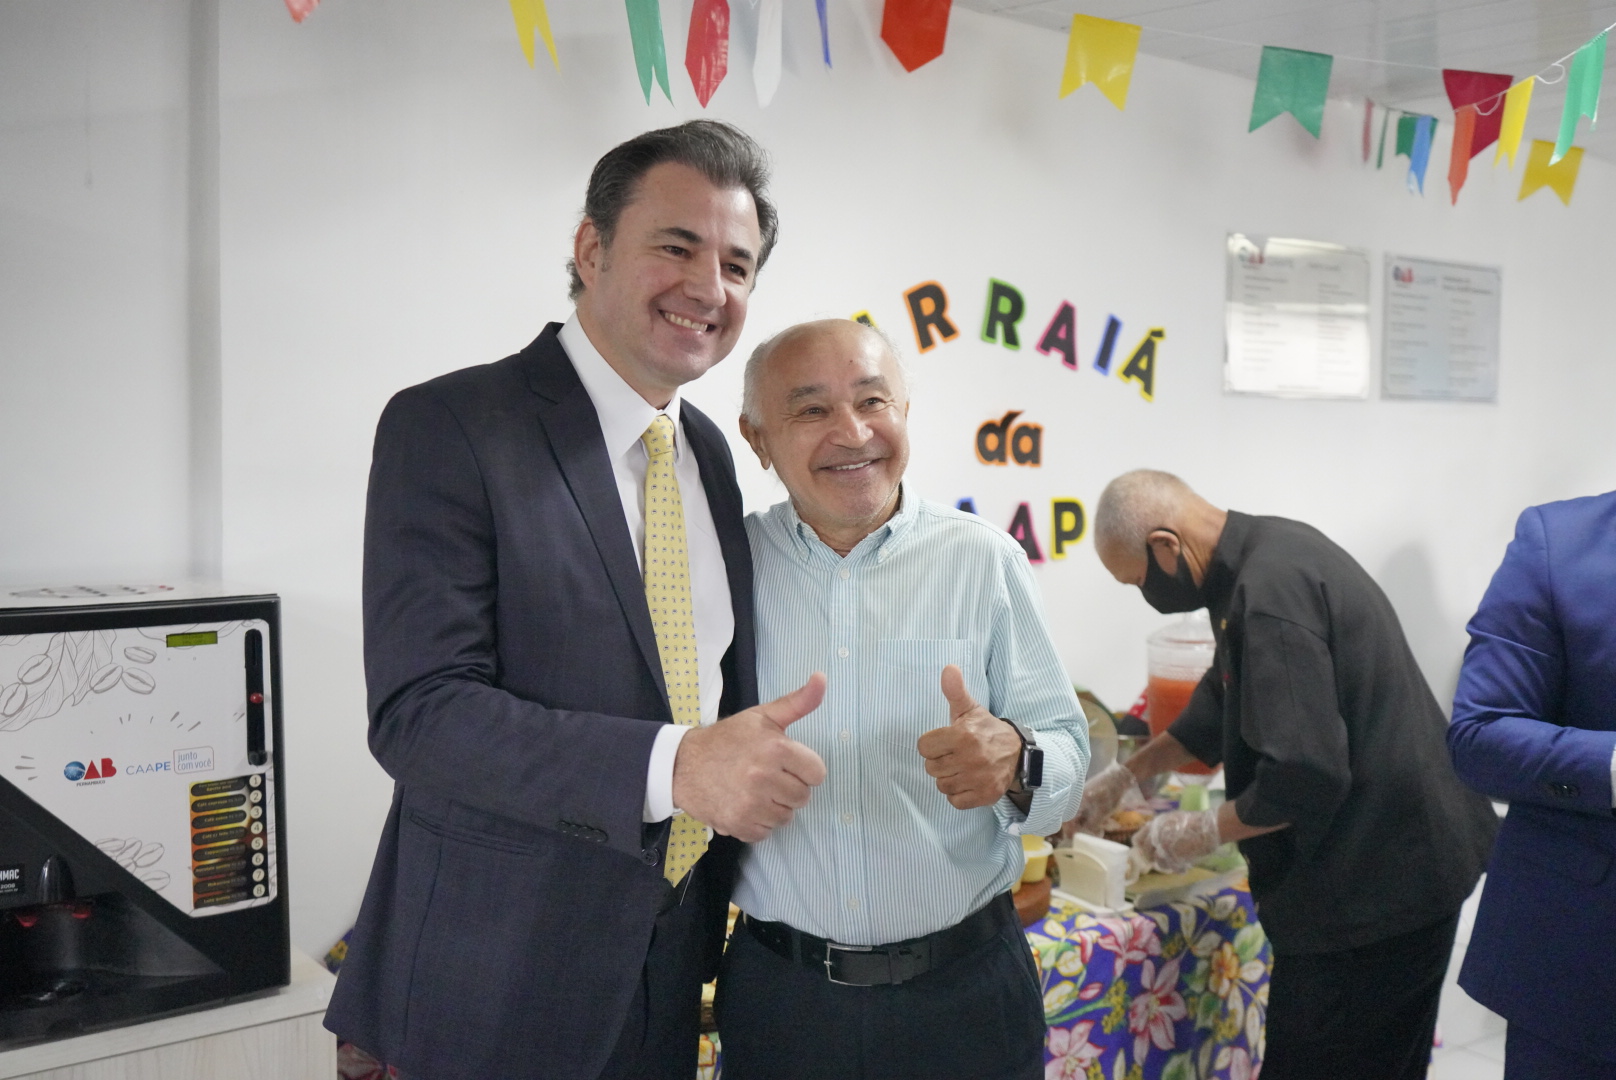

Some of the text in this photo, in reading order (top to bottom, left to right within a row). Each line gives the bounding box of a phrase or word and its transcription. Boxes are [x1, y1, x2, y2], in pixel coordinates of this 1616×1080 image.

[852, 278, 1165, 402] RRAIÁ
[975, 410, 1044, 467] da
[177, 751, 198, 763] junto
[177, 758, 212, 772] com você
[64, 758, 117, 781] OAB
[126, 761, 171, 775] CAAPE
